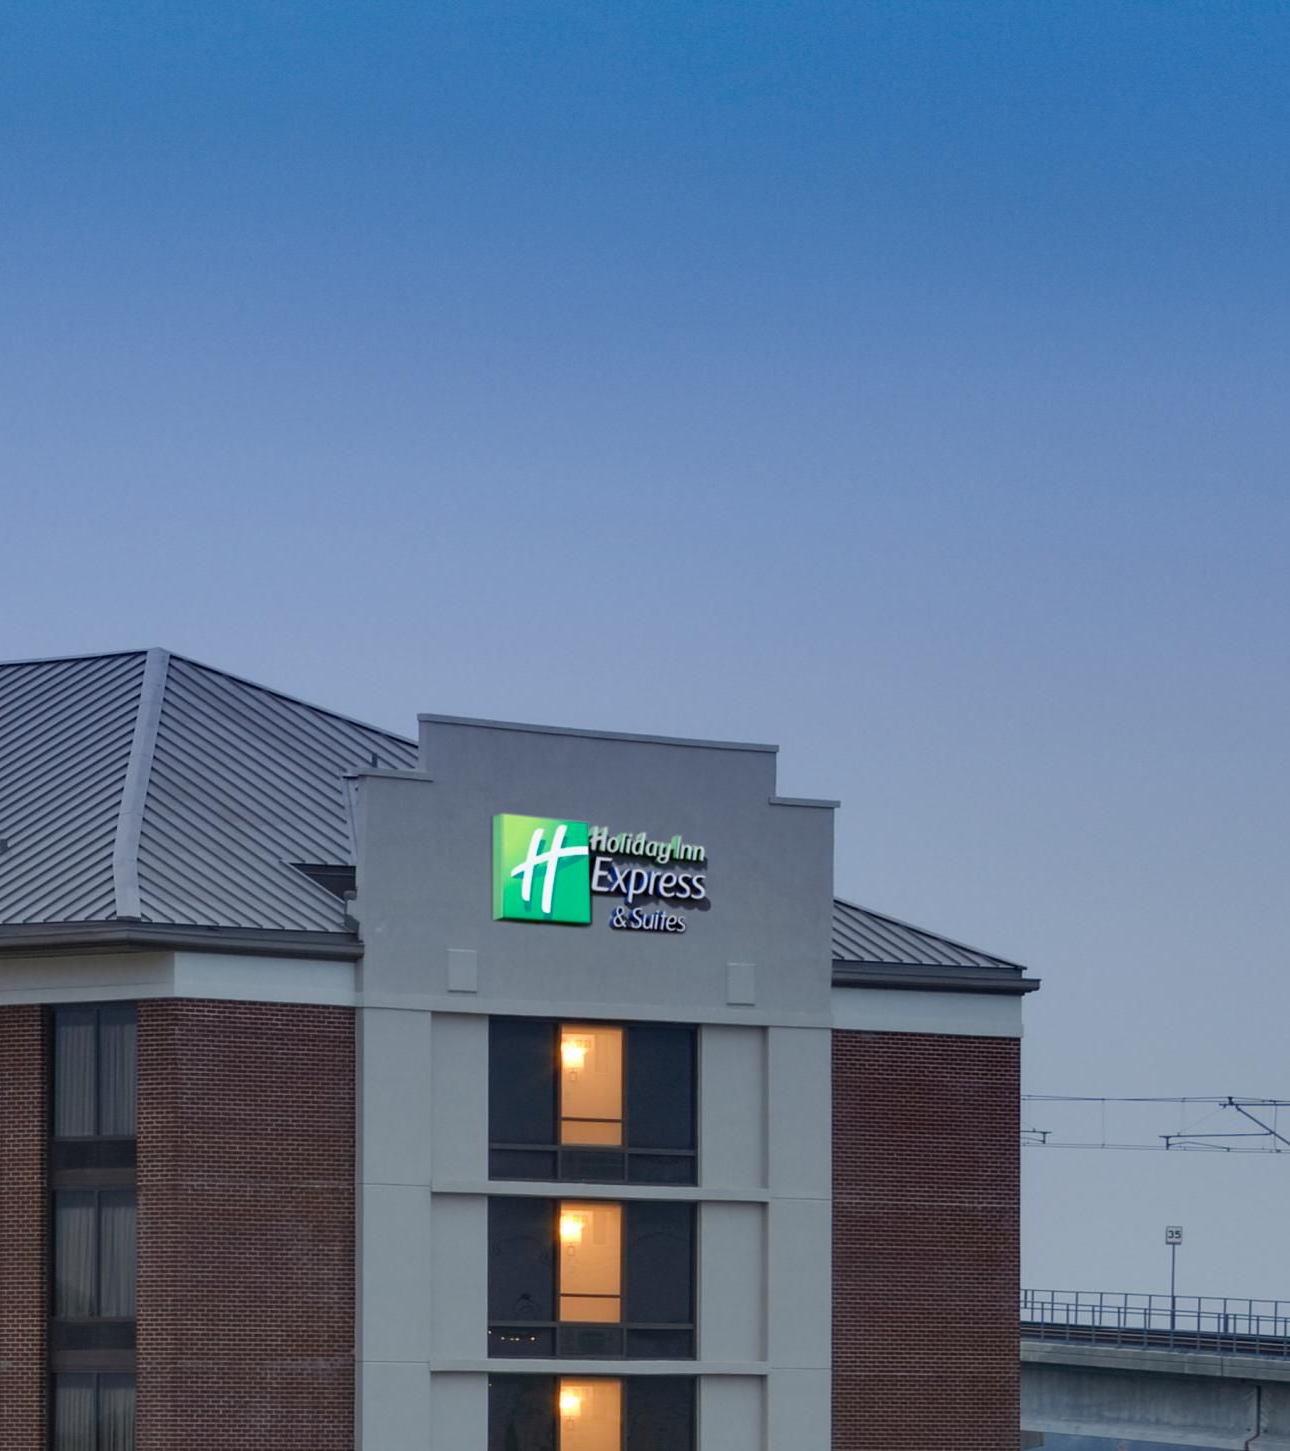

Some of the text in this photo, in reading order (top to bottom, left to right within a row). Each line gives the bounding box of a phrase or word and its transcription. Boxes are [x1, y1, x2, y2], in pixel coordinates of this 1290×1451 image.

[588, 825, 706, 864] Holiday Inn
[591, 856, 706, 904] Express
[612, 906, 686, 933] & Suites
[1168, 1230, 1181, 1239] 35
